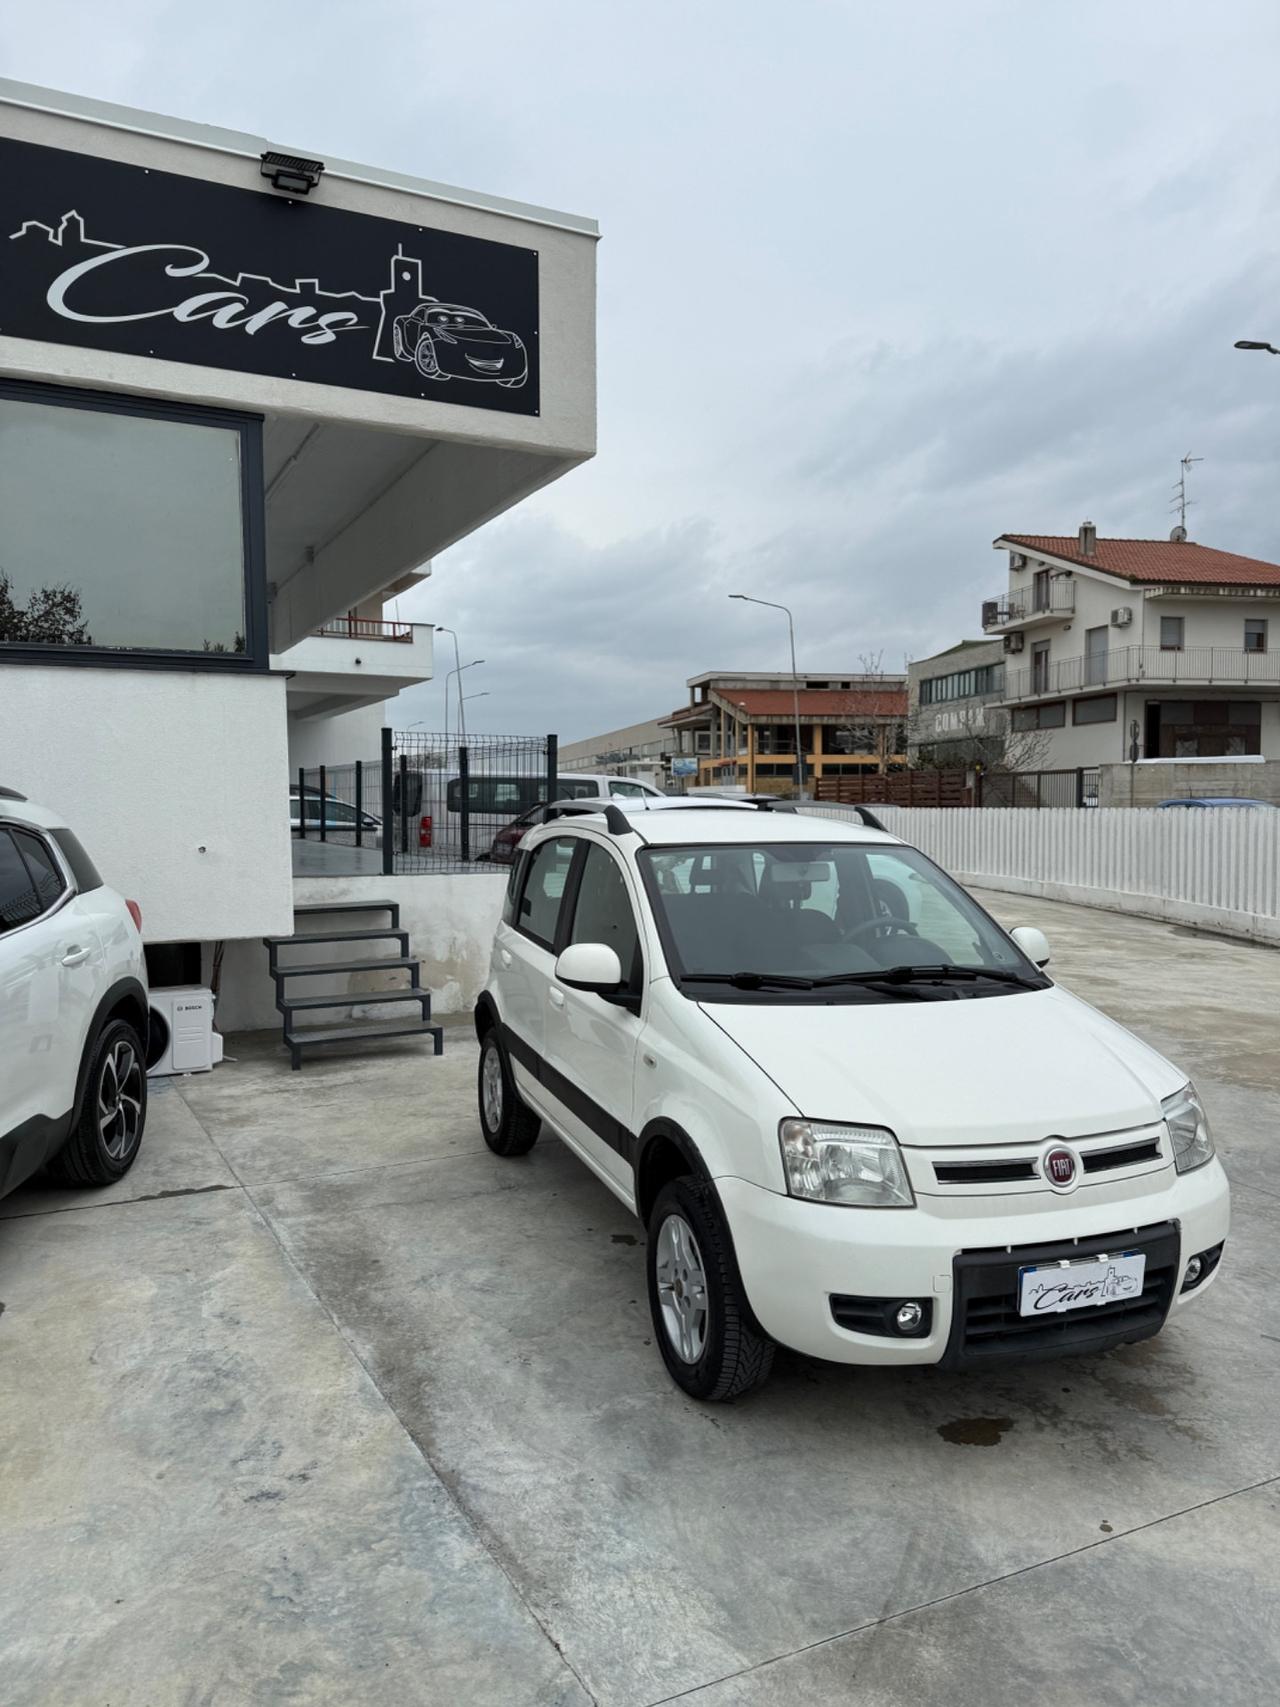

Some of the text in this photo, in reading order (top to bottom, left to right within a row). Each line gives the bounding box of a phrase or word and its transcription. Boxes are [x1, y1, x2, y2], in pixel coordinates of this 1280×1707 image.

[47, 244, 370, 344] Cars
[1052, 1158, 1073, 1177] FIAT
[1034, 1283, 1100, 1310] Cars
